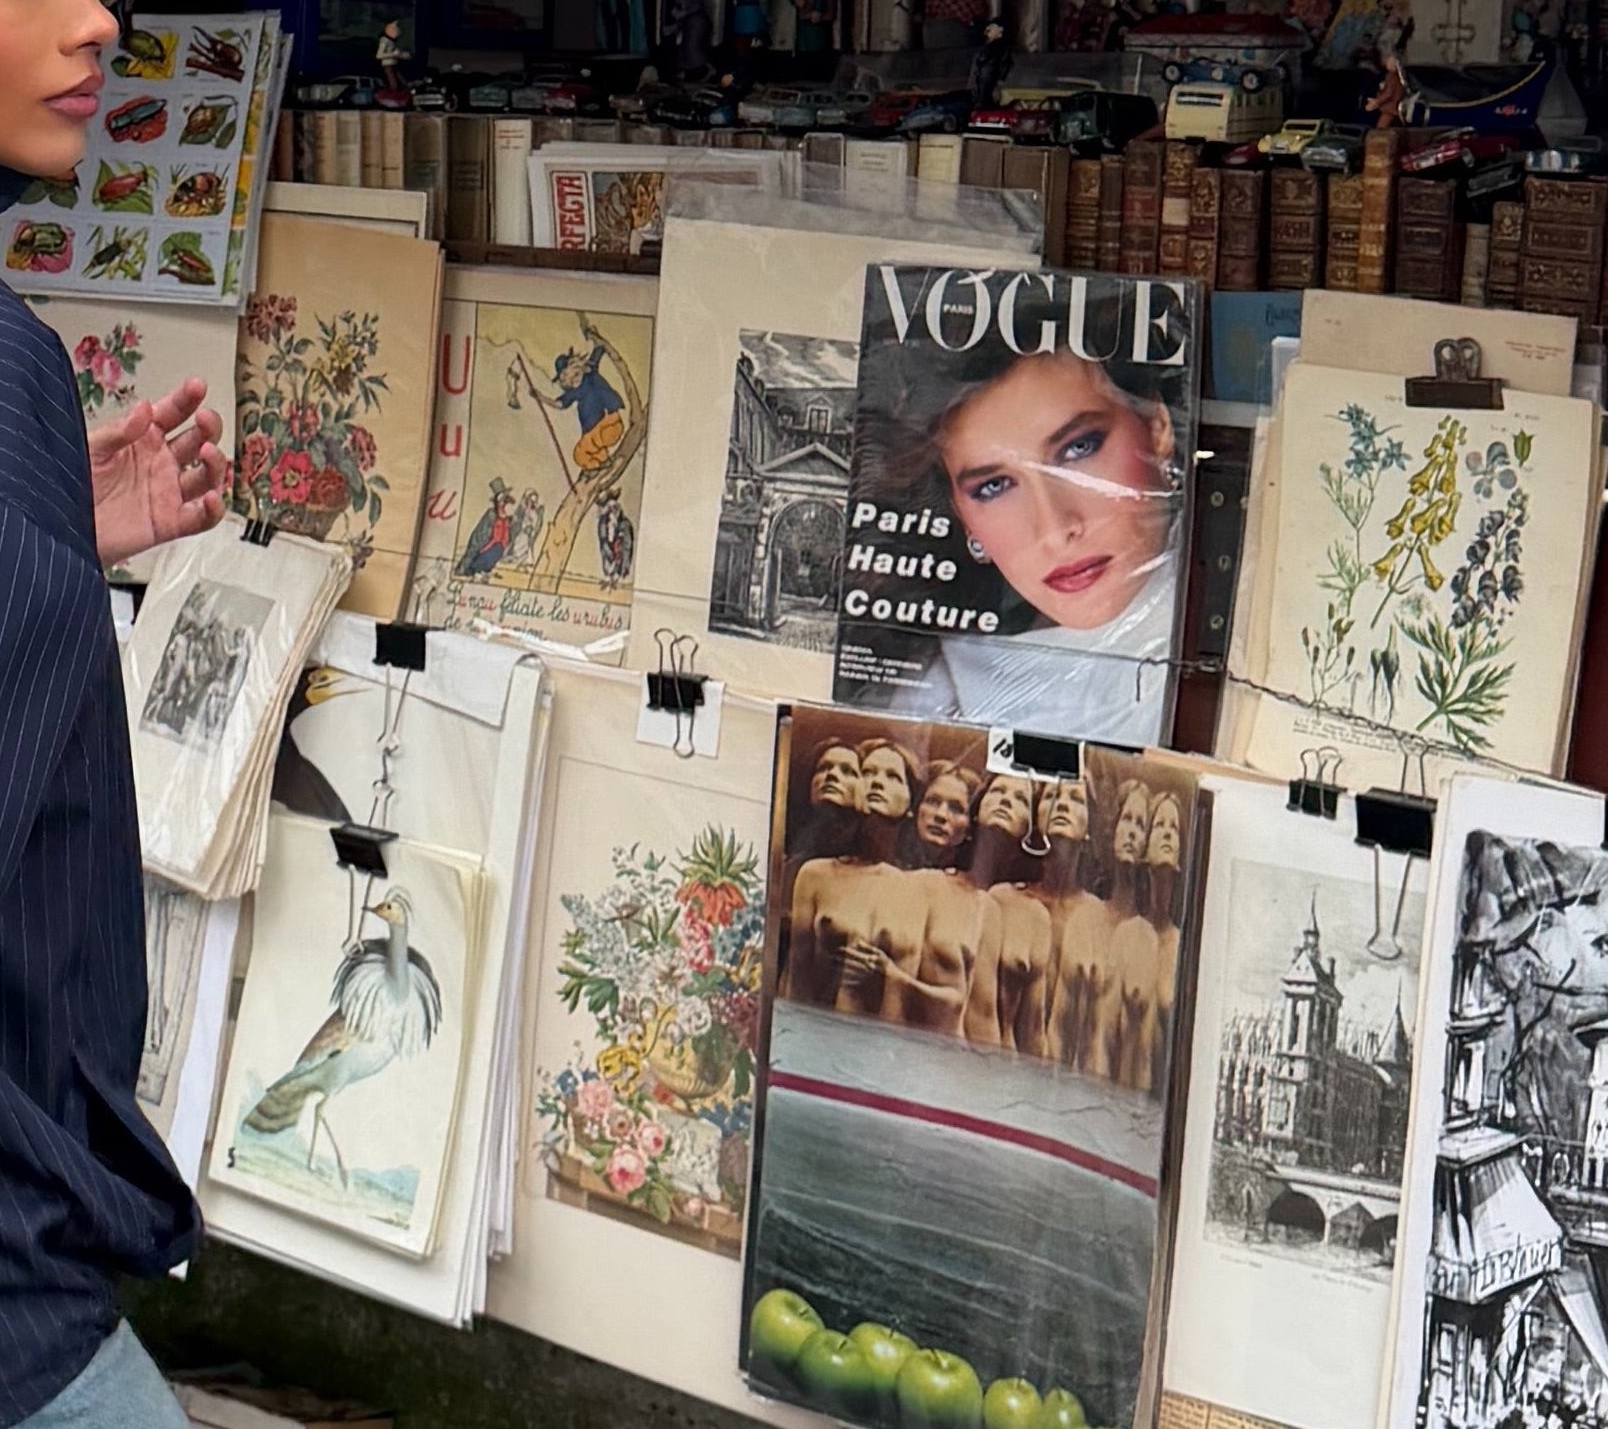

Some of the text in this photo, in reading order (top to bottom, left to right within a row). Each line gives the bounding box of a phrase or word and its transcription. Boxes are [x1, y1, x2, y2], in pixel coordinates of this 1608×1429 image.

[879, 265, 1187, 367] VOGUE
[442, 333, 472, 396] U
[439, 422, 463, 458] u
[851, 501, 951, 538] Paris
[847, 543, 958, 582] Haute
[547, 596, 570, 623] les
[844, 588, 1000, 633] Couture
